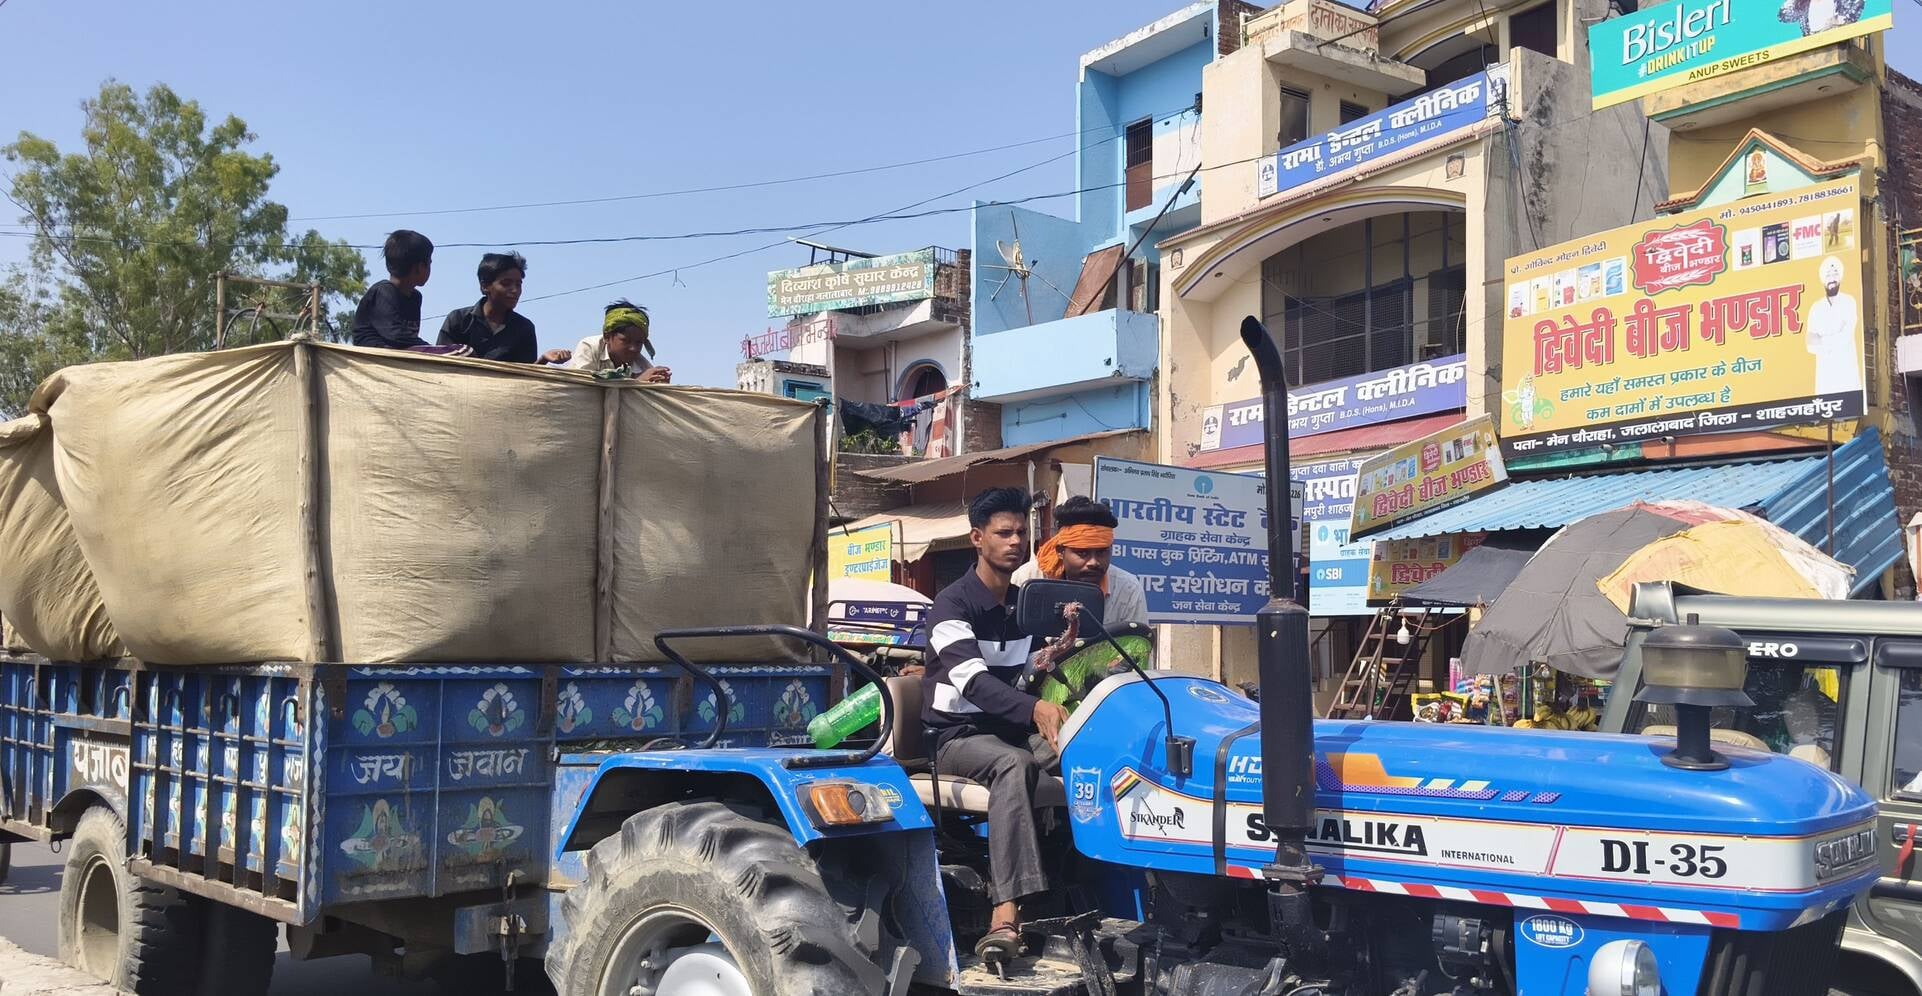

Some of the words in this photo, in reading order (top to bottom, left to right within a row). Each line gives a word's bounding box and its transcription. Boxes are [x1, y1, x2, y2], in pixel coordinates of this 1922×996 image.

[1621, 0, 1732, 65] Bisleri
[1637, 36, 1716, 78] #DRINKITUP
[1688, 62, 1719, 81] ANUP
[1722, 50, 1770, 71] SWEETS
[1281, 142, 1322, 170] रामा
[1388, 81, 1482, 126] क्लीनिक
[1329, 152, 1351, 168] अभय
[1354, 143, 1374, 162] गुप्ता
[1645, 238, 1715, 269] द्विवेदी
[1659, 260, 1681, 274] बीज
[1689, 253, 1722, 269] भण्डार
[1533, 307, 1620, 377] द्विवेदी
[1625, 299, 1693, 359] बीज
[1700, 284, 1806, 346] भण्डार
[1560, 380, 1592, 402] हमारे
[1595, 374, 1621, 395] यहाँ
[1624, 373, 1666, 392] समस्त
[1670, 366, 1708, 386] प्रकार
[1711, 361, 1727, 378] के
[1731, 356, 1763, 375] बीज
[1228, 404, 1264, 426] राम
[1355, 361, 1467, 401] क्लीनिक
[1586, 407, 1611, 421] कम
[1615, 396, 1645, 418] दामों
[1649, 394, 1663, 412] में
[1665, 391, 1716, 411] उपलब्ध
[1720, 384, 1733, 403] है
[1311, 411, 1335, 430] गुप्ता
[1340, 408, 1361, 419] B.D.S.
[1546, 430, 1569, 448] मेन
[1698, 410, 1738, 430] जिला
[1756, 398, 1845, 421] शाहजहाँपुर
[1312, 463, 1327, 475] दवा
[1372, 484, 1415, 519] द्विवेदी
[1418, 475, 1449, 501] बीज
[1450, 459, 1490, 489] भण्डार
[1203, 503, 1247, 528] स्टेट
[1160, 530, 1196, 542] ग्राहक
[1200, 530, 1222, 543] सेवा
[1226, 531, 1251, 546] केन्द्र
[1111, 545, 1126, 557] BI
[1131, 546, 1157, 560] पास
[1161, 548, 1184, 566] बुक
[1171, 571, 1249, 596] संशोधन
[1326, 568, 1342, 580] SBI
[1172, 600, 1192, 610] जन
[1194, 599, 1215, 611] सेवा
[1218, 599, 1241, 613] केन्द्र
[1748, 642, 1798, 658] ERO
[1075, 783, 1094, 800] 39
[1130, 807, 1185, 829] SIKANDER
[1246, 812, 1427, 856] SALIKA
[1441, 850, 1515, 864] INTERNATIONAL
[1600, 839, 1728, 878] DI-35
[1530, 919, 1556, 932] 1800
[1559, 920, 1573, 935] Kg
